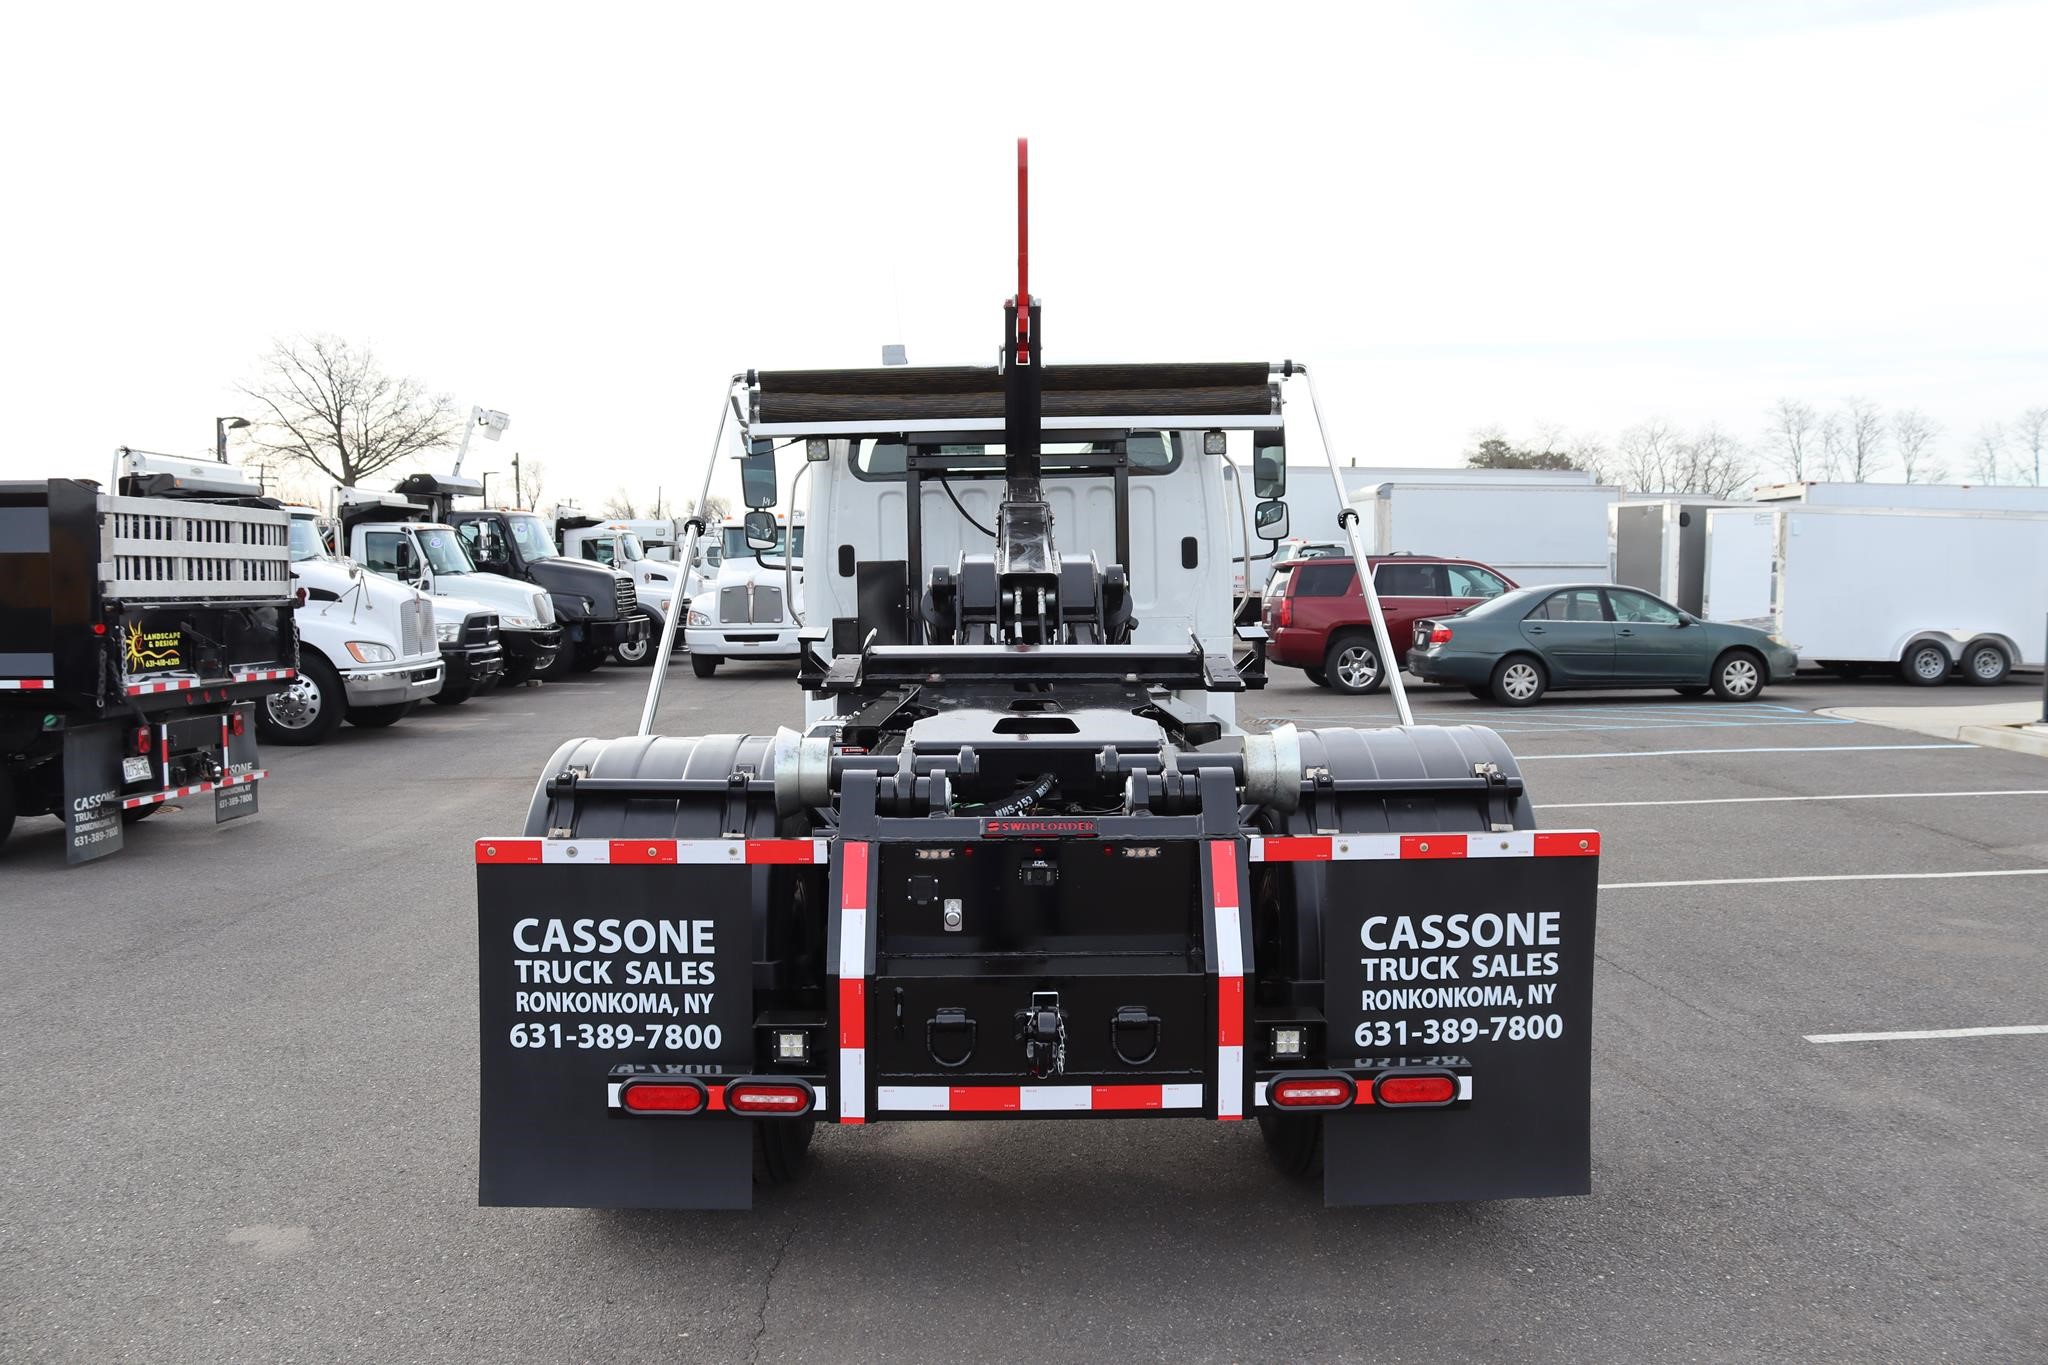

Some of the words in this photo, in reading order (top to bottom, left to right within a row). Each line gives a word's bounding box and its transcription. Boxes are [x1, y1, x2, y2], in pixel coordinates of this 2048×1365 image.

[143, 632, 181, 641] LANDSCAPE
[155, 639, 179, 648] DESIGN
[1002, 822, 1094, 831] SWAPLOADER
[513, 918, 715, 954] CASSONE
[1361, 911, 1561, 951] CASSONE
[514, 960, 613, 984] TRUCK
[625, 960, 716, 985] SALES
[1361, 955, 1459, 981] TRUCK
[1472, 952, 1559, 978] SALES
[516, 992, 680, 1017] RONKONKOMA,
[684, 993, 715, 1014] NY
[1362, 984, 1524, 1011] RONKONKOMA,
[1528, 983, 1558, 1005] NY
[510, 1023, 722, 1050] 631-389-7800
[1354, 1014, 1563, 1047] 631-389-7800
